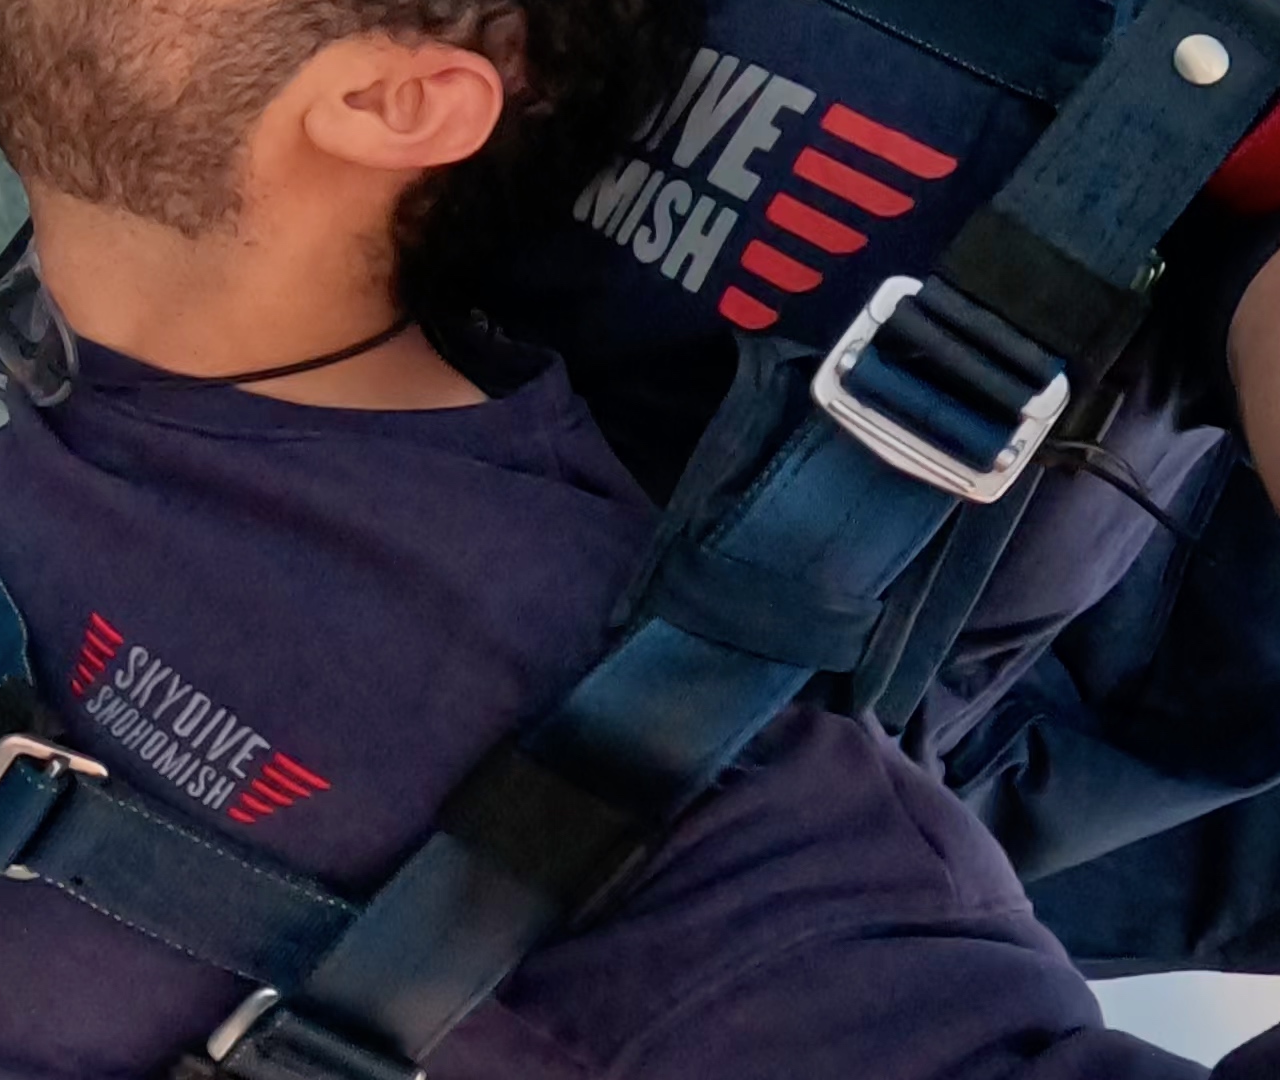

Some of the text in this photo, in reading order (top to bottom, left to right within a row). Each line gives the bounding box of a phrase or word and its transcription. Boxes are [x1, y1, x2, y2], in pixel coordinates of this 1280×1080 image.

[631, 47, 818, 202] IVE
[86, 685, 236, 810] SNOHOMISH
[114, 645, 271, 779] SKYDIVE
